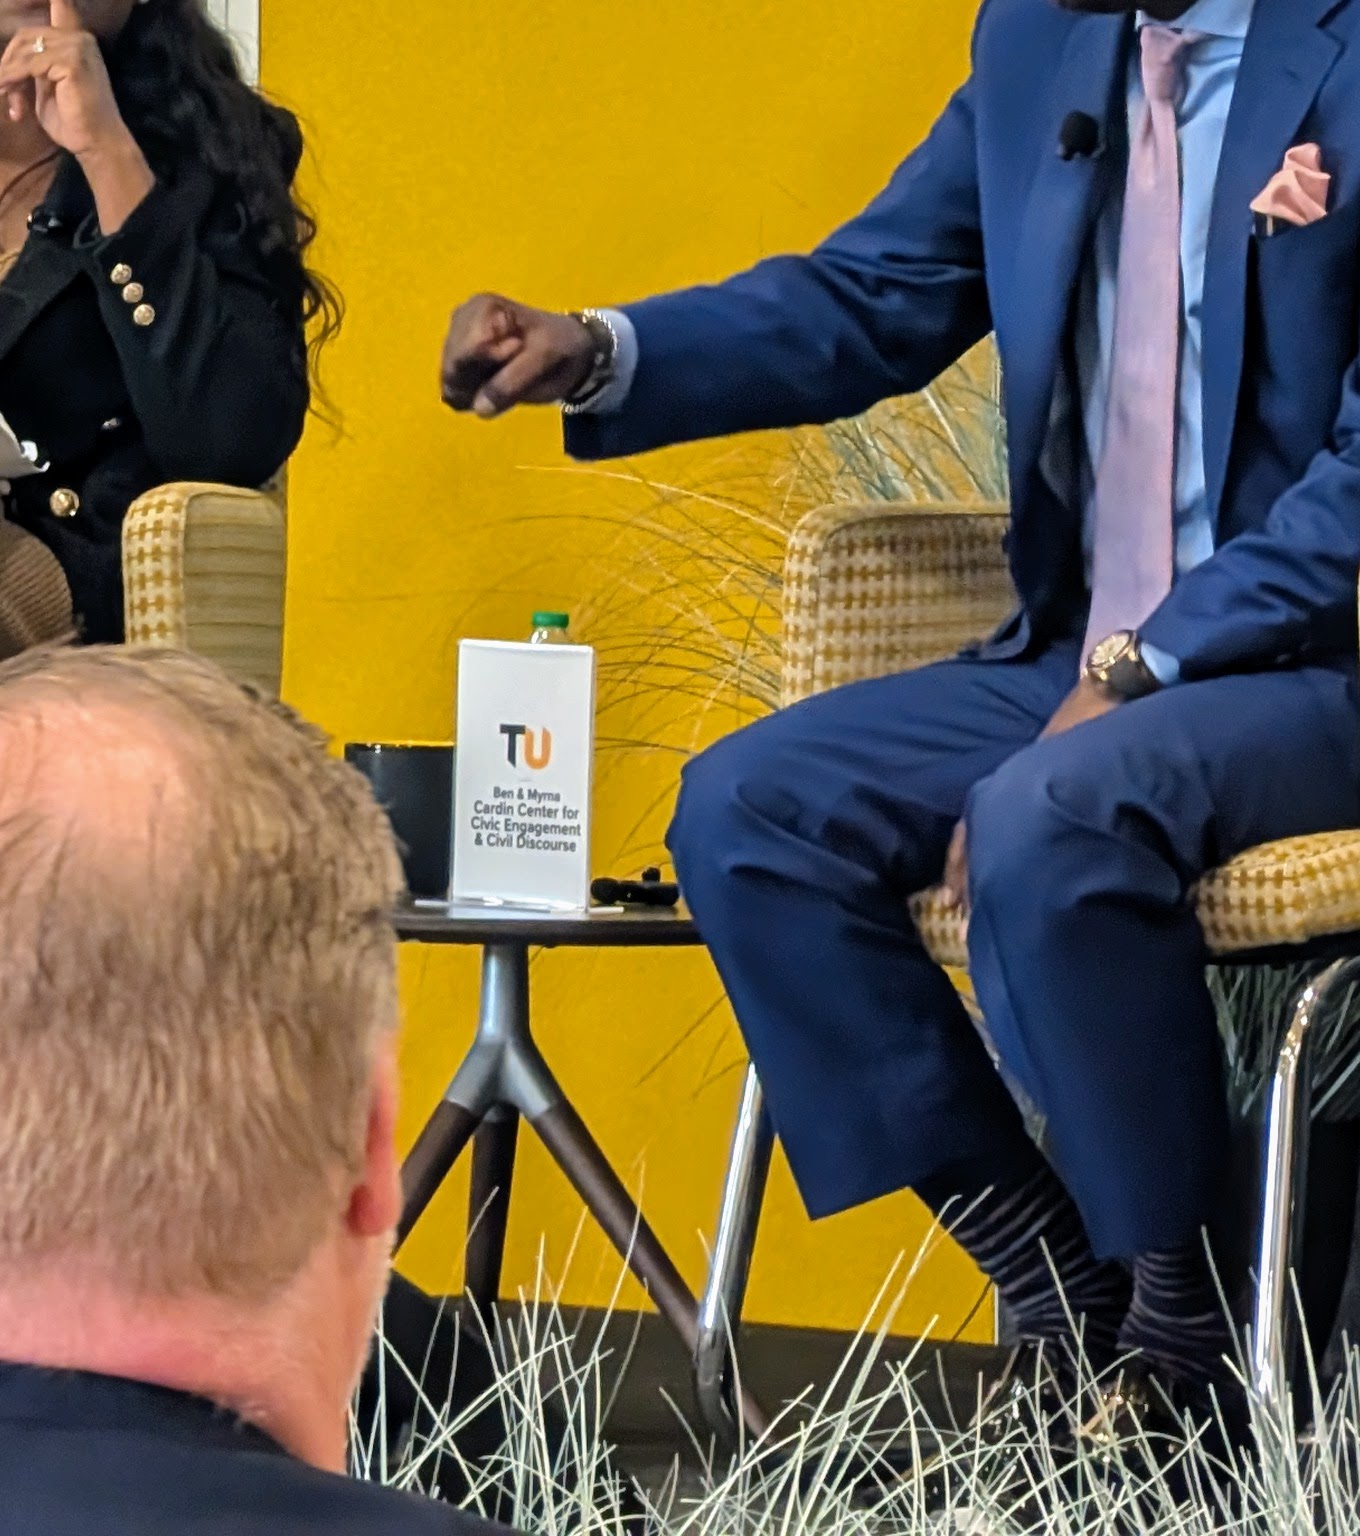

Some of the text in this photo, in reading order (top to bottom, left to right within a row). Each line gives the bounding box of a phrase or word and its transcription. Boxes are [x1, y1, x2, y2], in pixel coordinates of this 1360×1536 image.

[499, 724, 552, 770] TU
[493, 786, 561, 803] Ben & Myrna
[473, 800, 580, 820] Cardin Center for
[471, 816, 581, 837] Civic Engagement
[474, 832, 577, 852] & Civil Discourse
